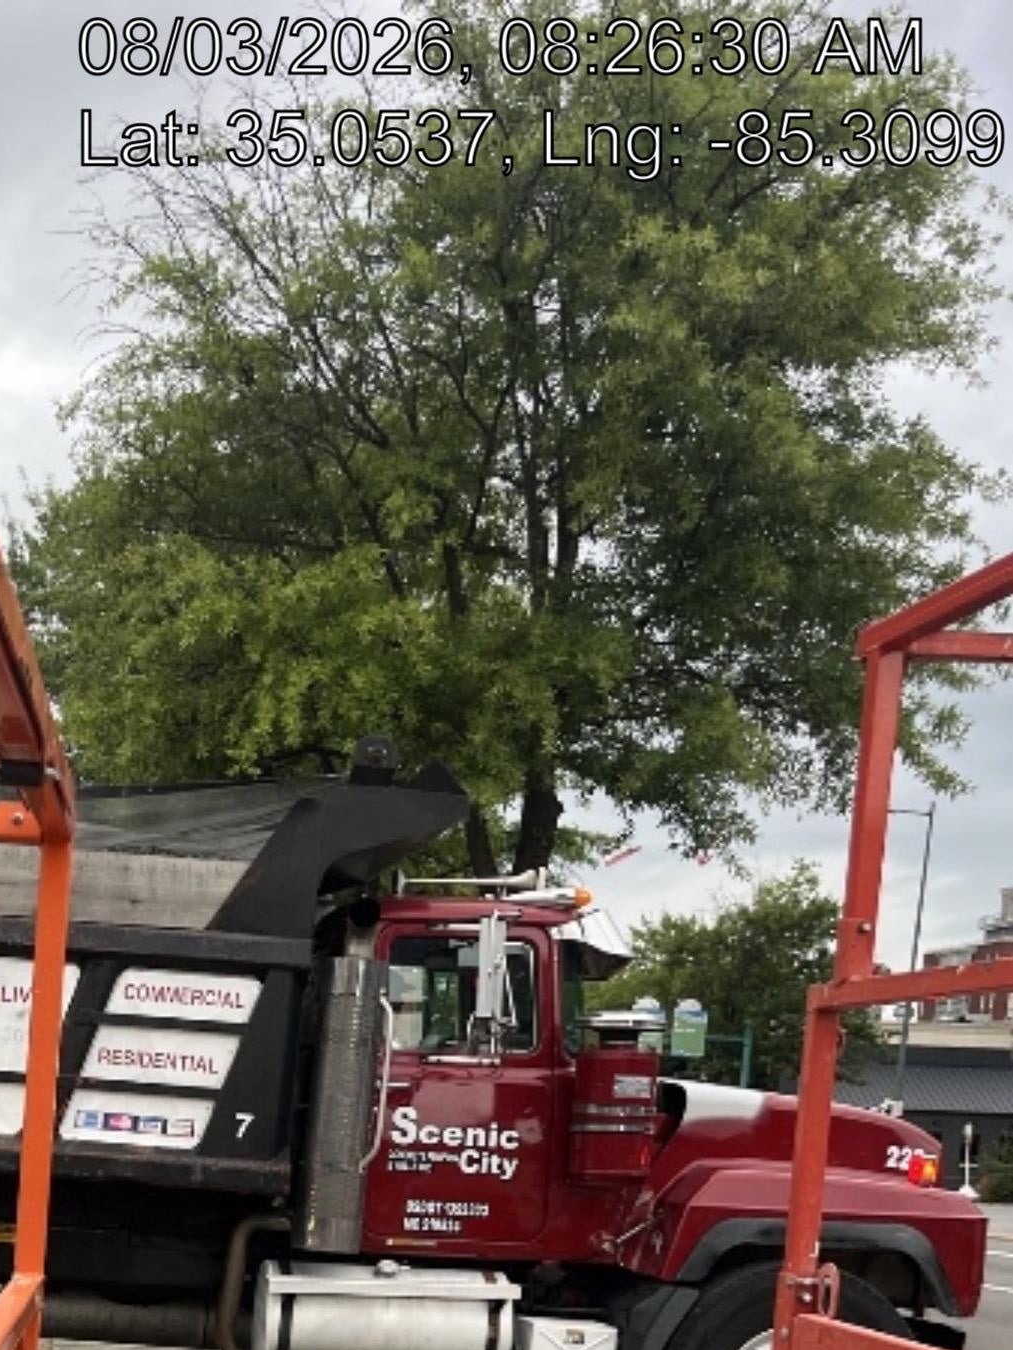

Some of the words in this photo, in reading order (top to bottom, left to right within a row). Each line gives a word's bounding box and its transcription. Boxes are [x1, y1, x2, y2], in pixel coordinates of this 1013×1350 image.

[124, 983, 246, 1009] COMMERCIAL
[97, 1048, 219, 1075] RESIDENTIAL
[234, 1112, 255, 1138] 7
[390, 1105, 520, 1150] Scenic
[459, 1148, 519, 1180] City
